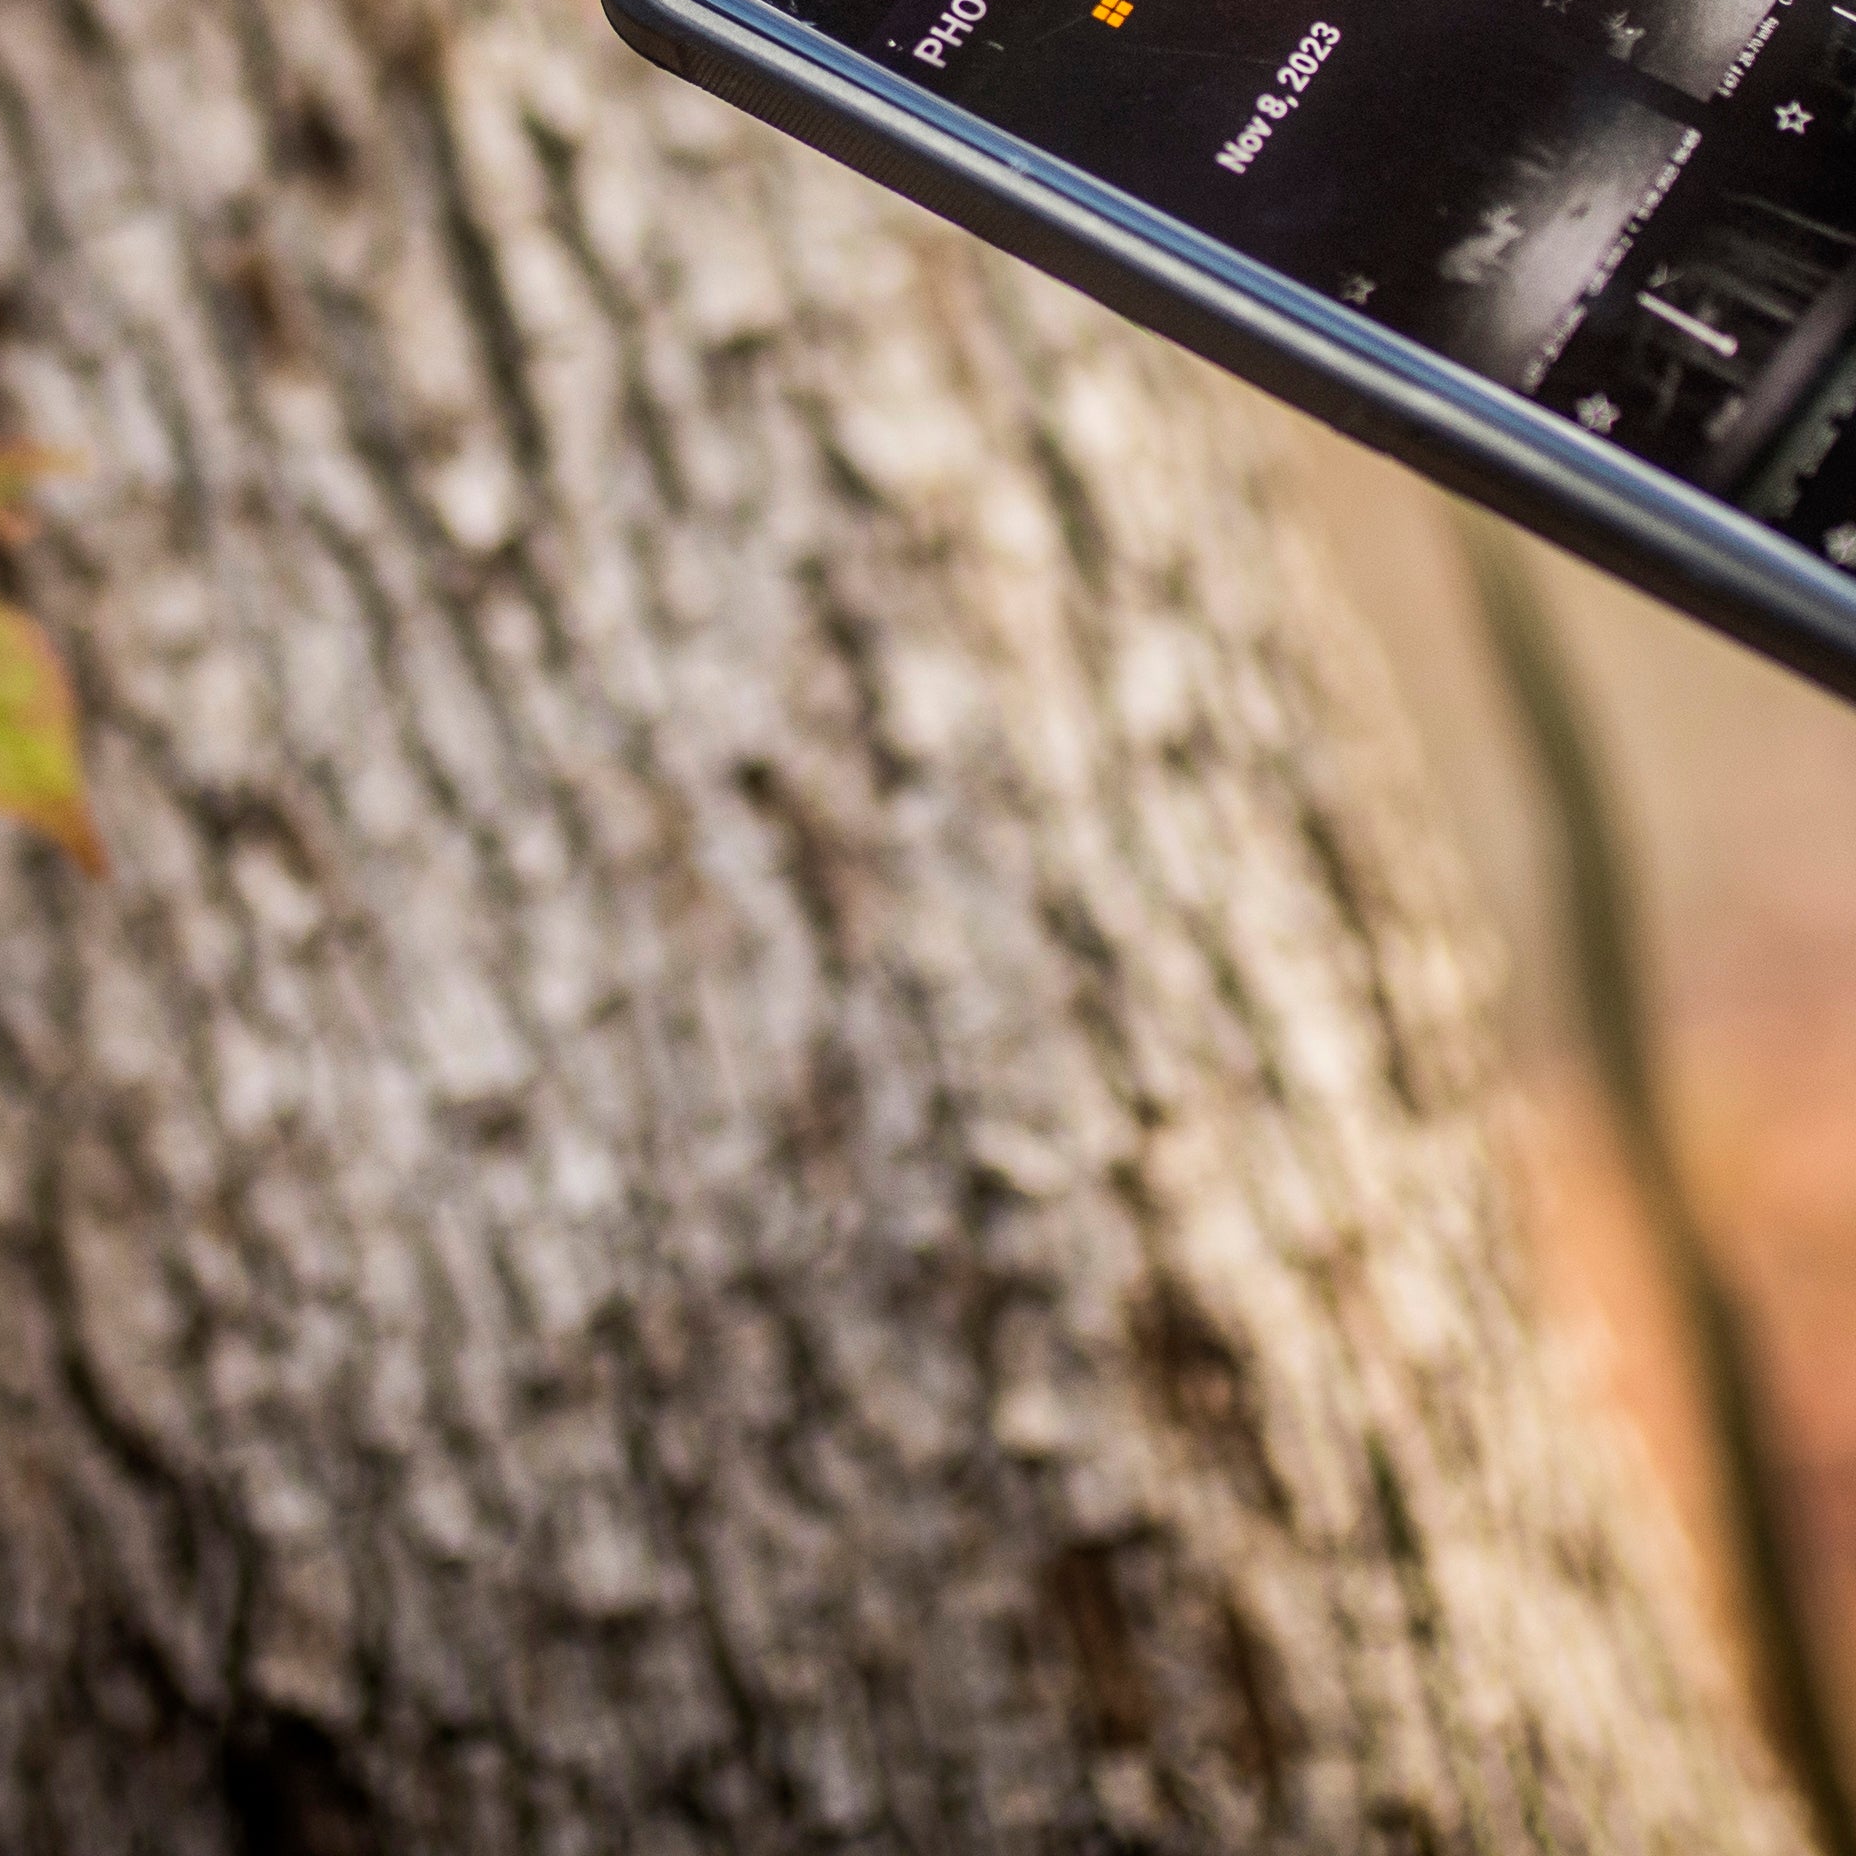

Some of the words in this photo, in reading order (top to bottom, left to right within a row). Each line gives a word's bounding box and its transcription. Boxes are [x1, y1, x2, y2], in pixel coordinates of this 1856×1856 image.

[1276, 21, 1342, 93] 2023
[1256, 93, 1300, 120] 8,
[1214, 115, 1273, 175] Nov
